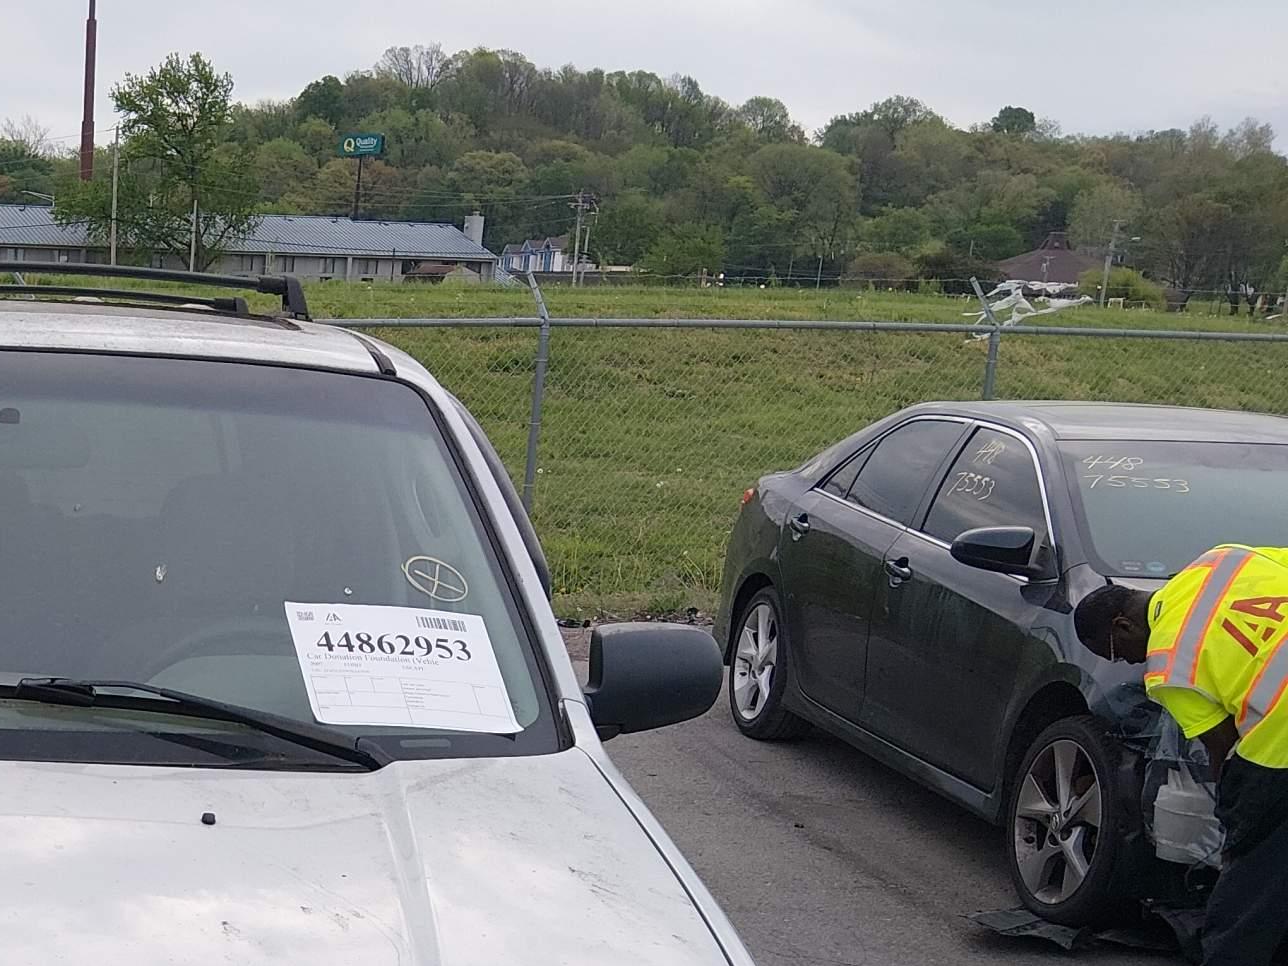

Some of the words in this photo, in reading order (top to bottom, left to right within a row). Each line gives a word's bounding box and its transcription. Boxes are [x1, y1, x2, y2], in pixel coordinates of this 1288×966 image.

[1082, 455, 1143, 470] 448
[947, 472, 995, 501] 75553
[1082, 474, 1190, 493] 75553
[316, 630, 472, 662] 44862953
[306, 652, 322, 660] Car
[323, 653, 362, 662] Donation
[364, 655, 410, 664] Foundation
